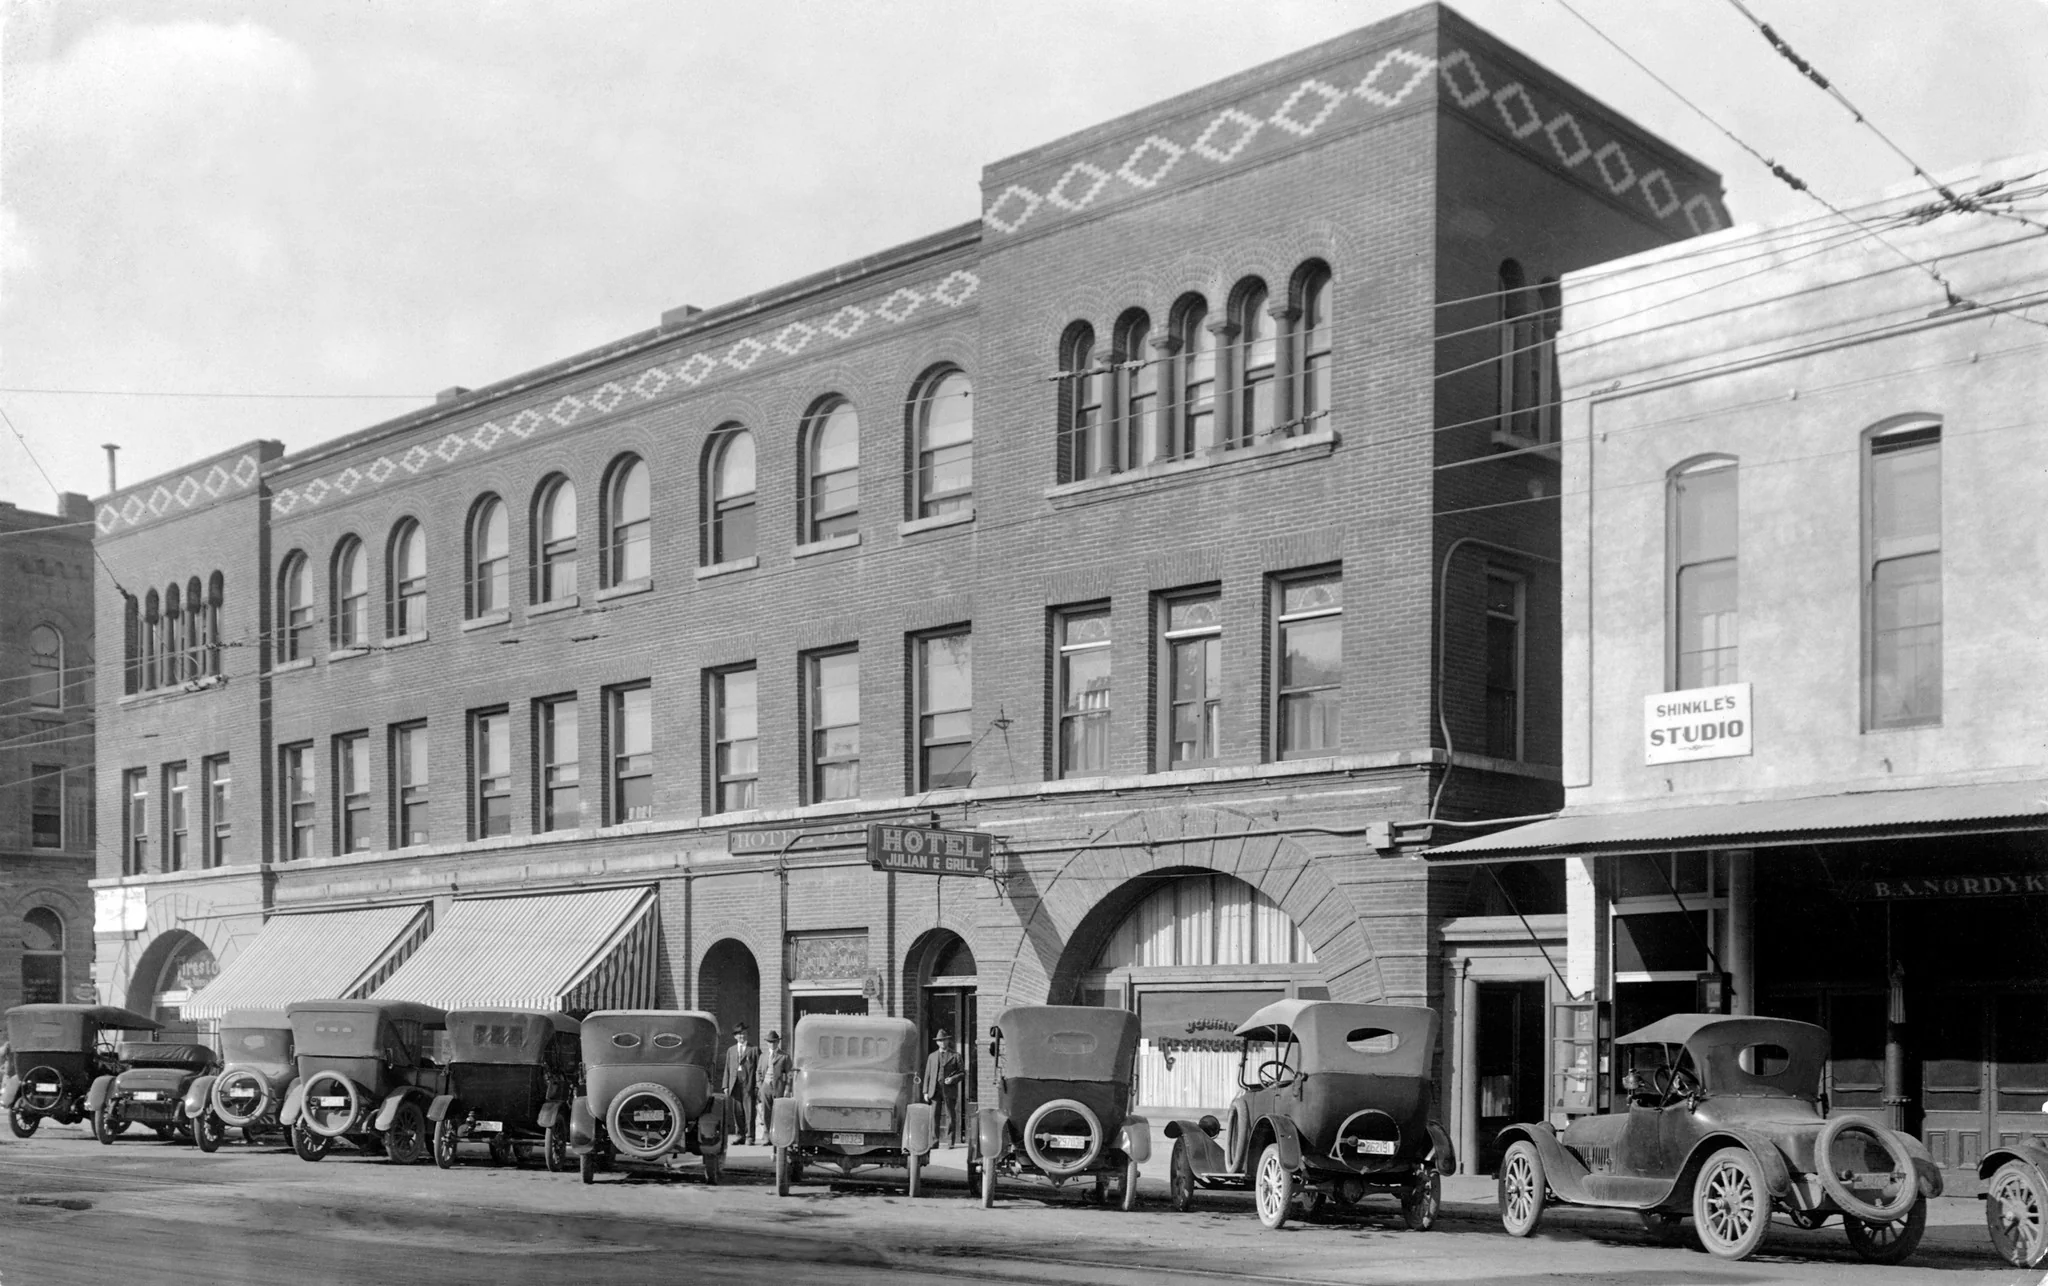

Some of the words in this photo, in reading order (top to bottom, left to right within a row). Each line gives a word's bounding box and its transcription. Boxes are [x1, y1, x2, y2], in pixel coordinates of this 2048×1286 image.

[1656, 695, 1736, 717] SHINKLE'S
[1650, 719, 1744, 746] STUDIO
[738, 829, 814, 848] HOTEL
[882, 829, 984, 858] HOTEL
[886, 853, 928, 868] JULIAN
[932, 857, 940, 869] &
[946, 858, 979, 871] GRILL
[1923, 875, 2048, 895] NORDYK
